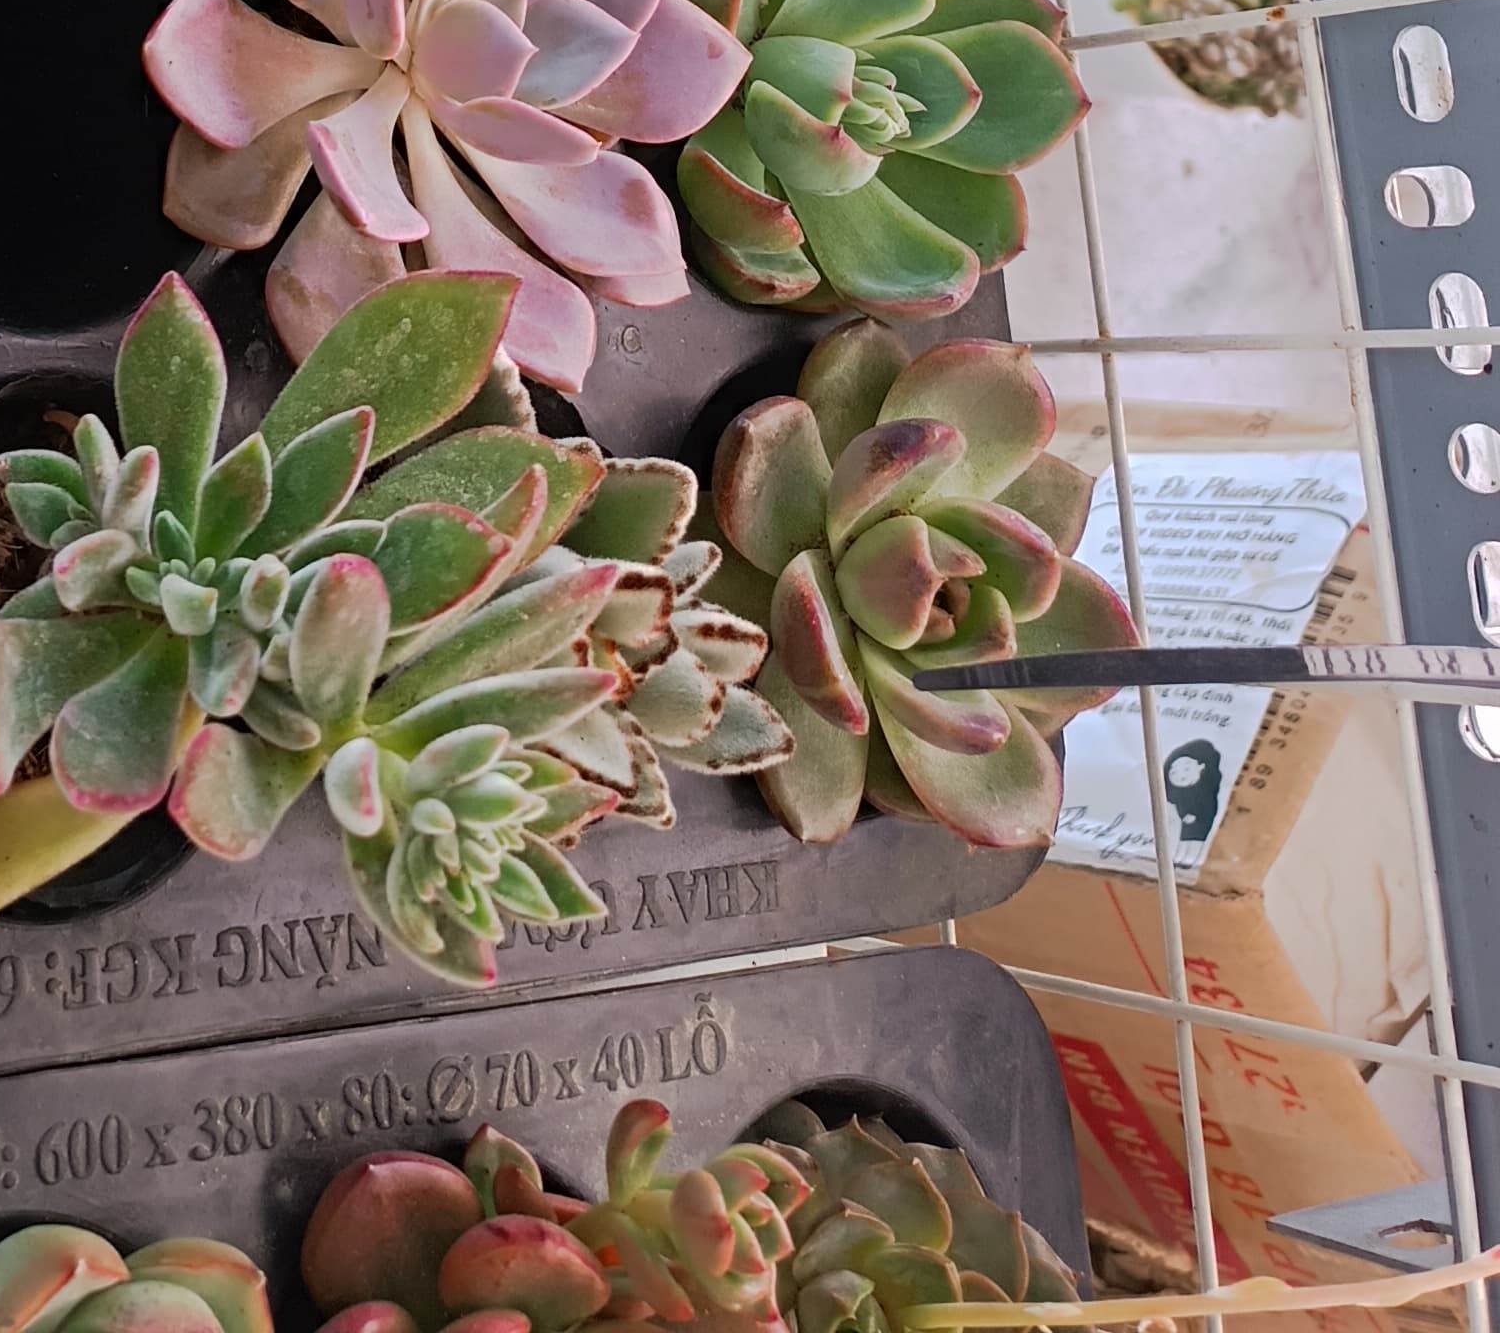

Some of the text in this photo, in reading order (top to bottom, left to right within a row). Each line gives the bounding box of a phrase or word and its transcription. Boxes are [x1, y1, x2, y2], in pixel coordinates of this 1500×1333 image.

[632, 860, 781, 932] KHAY
[45, 934, 198, 1012] KGF:
[212, 912, 389, 989] NĂNG
[33, 1111, 135, 1187] 600
[142, 1121, 179, 1169] x
[187, 1090, 287, 1163] 380
[485, 1048, 543, 1112] 70
[552, 1057, 584, 1101] x
[593, 1031, 647, 1092] 40
